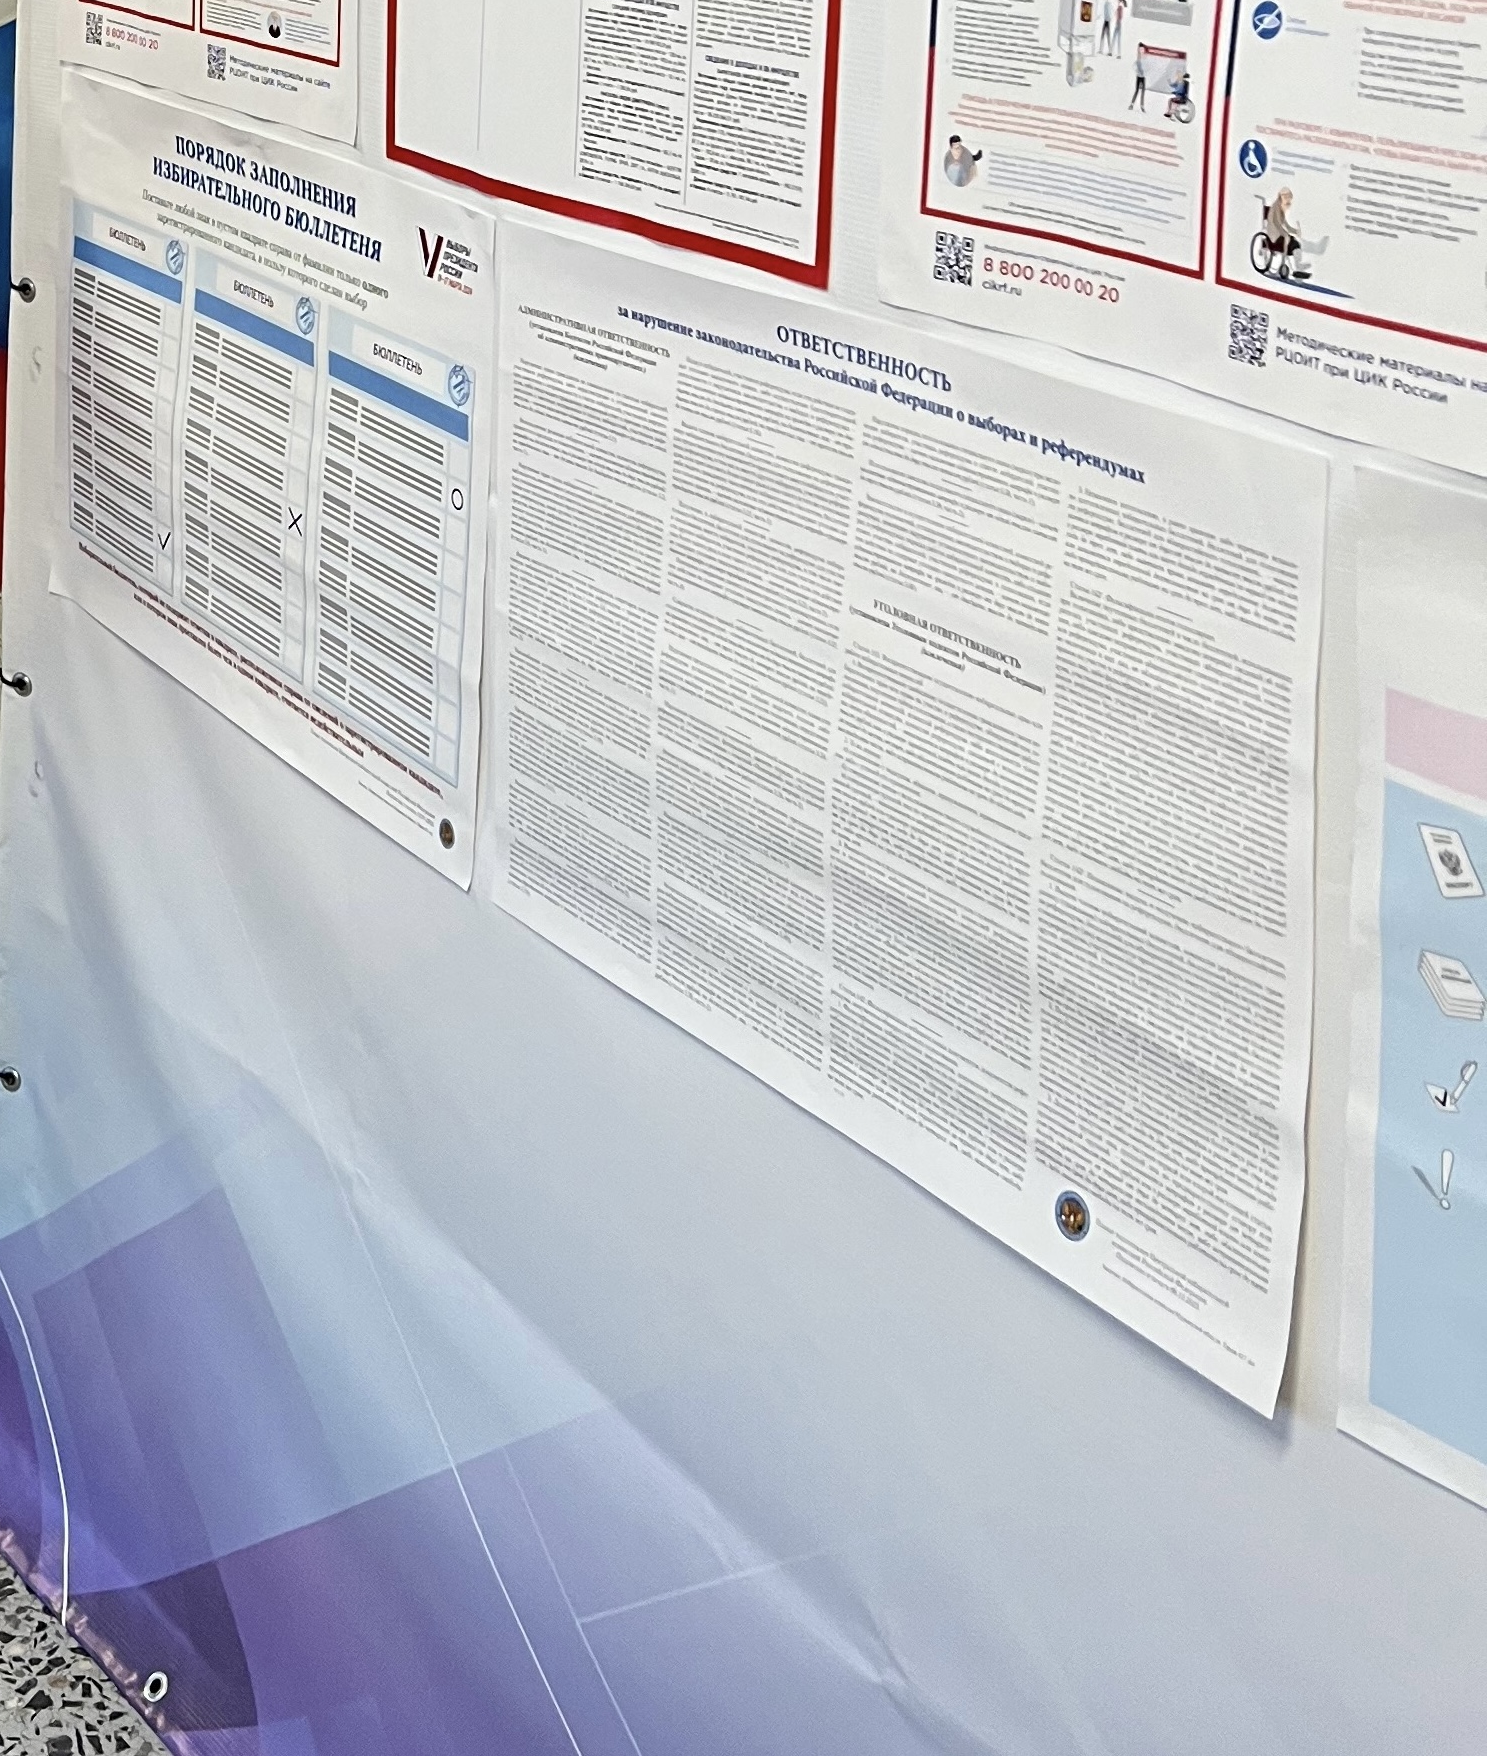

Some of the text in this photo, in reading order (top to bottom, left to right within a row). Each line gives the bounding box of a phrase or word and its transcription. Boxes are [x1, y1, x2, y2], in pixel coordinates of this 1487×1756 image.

[175, 135, 357, 218] ПОРЯДОК ЗАПОЛНЕНИЯ
[153, 156, 382, 263] ИЗБИРАТЕЛЬНОГО БЮЛЛЕТЕНЯ
[983, 257, 993, 272] 8
[999, 260, 1034, 280] 800
[1040, 269, 1071, 289] 200
[1074, 277, 1093, 296] 00
[1098, 284, 1120, 303] 20
[373, 343, 422, 375] БЮЛЛЕТЕНЬ
[777, 326, 951, 392] ОТВЕТСТВЕННОСТЬ
[1277, 326, 1375, 364] Методические
[1380, 355, 1466, 388] материалы
[1323, 363, 1349, 379] при
[1354, 367, 1388, 389] ЦИК
[1392, 378, 1448, 404] России
[617, 306, 1146, 483] за нарушение законодательства Российской Федерации о выборах и референдумах
